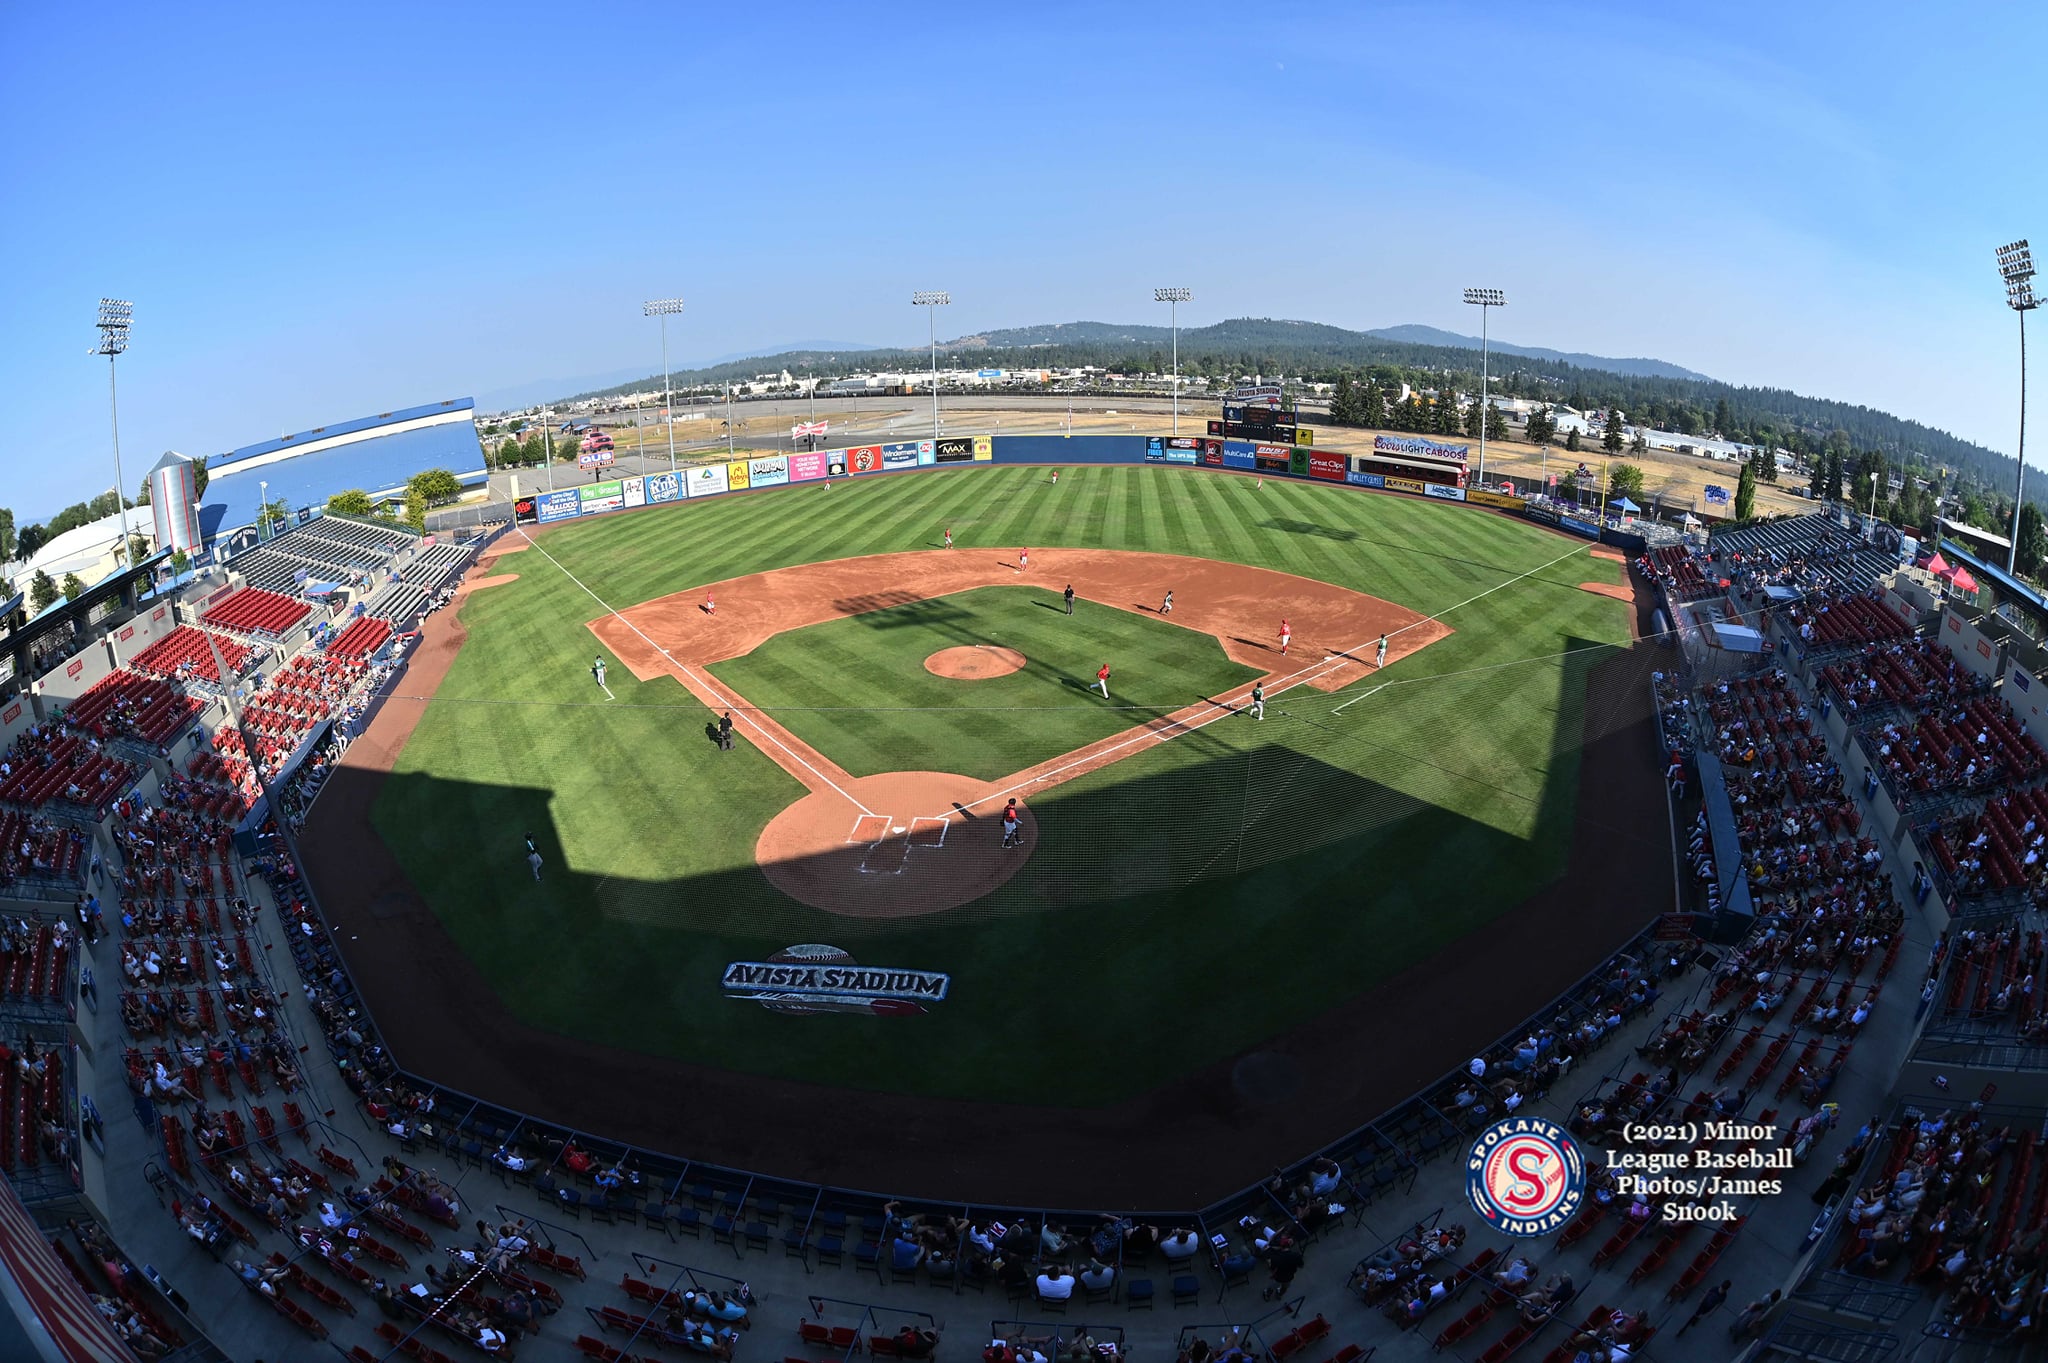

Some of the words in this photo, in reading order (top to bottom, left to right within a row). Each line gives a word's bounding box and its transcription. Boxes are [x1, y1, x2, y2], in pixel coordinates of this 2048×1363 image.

[1237, 389, 1255, 398] AVISTA
[1256, 387, 1280, 396] STADIUM
[942, 444, 966, 454] MAX
[1257, 446, 1289, 456] BNSF
[1374, 436, 1400, 451] Coors
[1401, 446, 1424, 454] LIGHT
[1425, 447, 1467, 460] CABOOSE
[884, 450, 916, 458] Windermere
[1224, 449, 1247, 458] MultiCare
[1310, 458, 1328, 467] Great
[1328, 460, 1344, 469] Clips
[730, 473, 748, 482] Arby's
[1386, 478, 1422, 491] AZTECA
[726, 964, 817, 989] AVISTA
[822, 968, 946, 997] STADIUM
